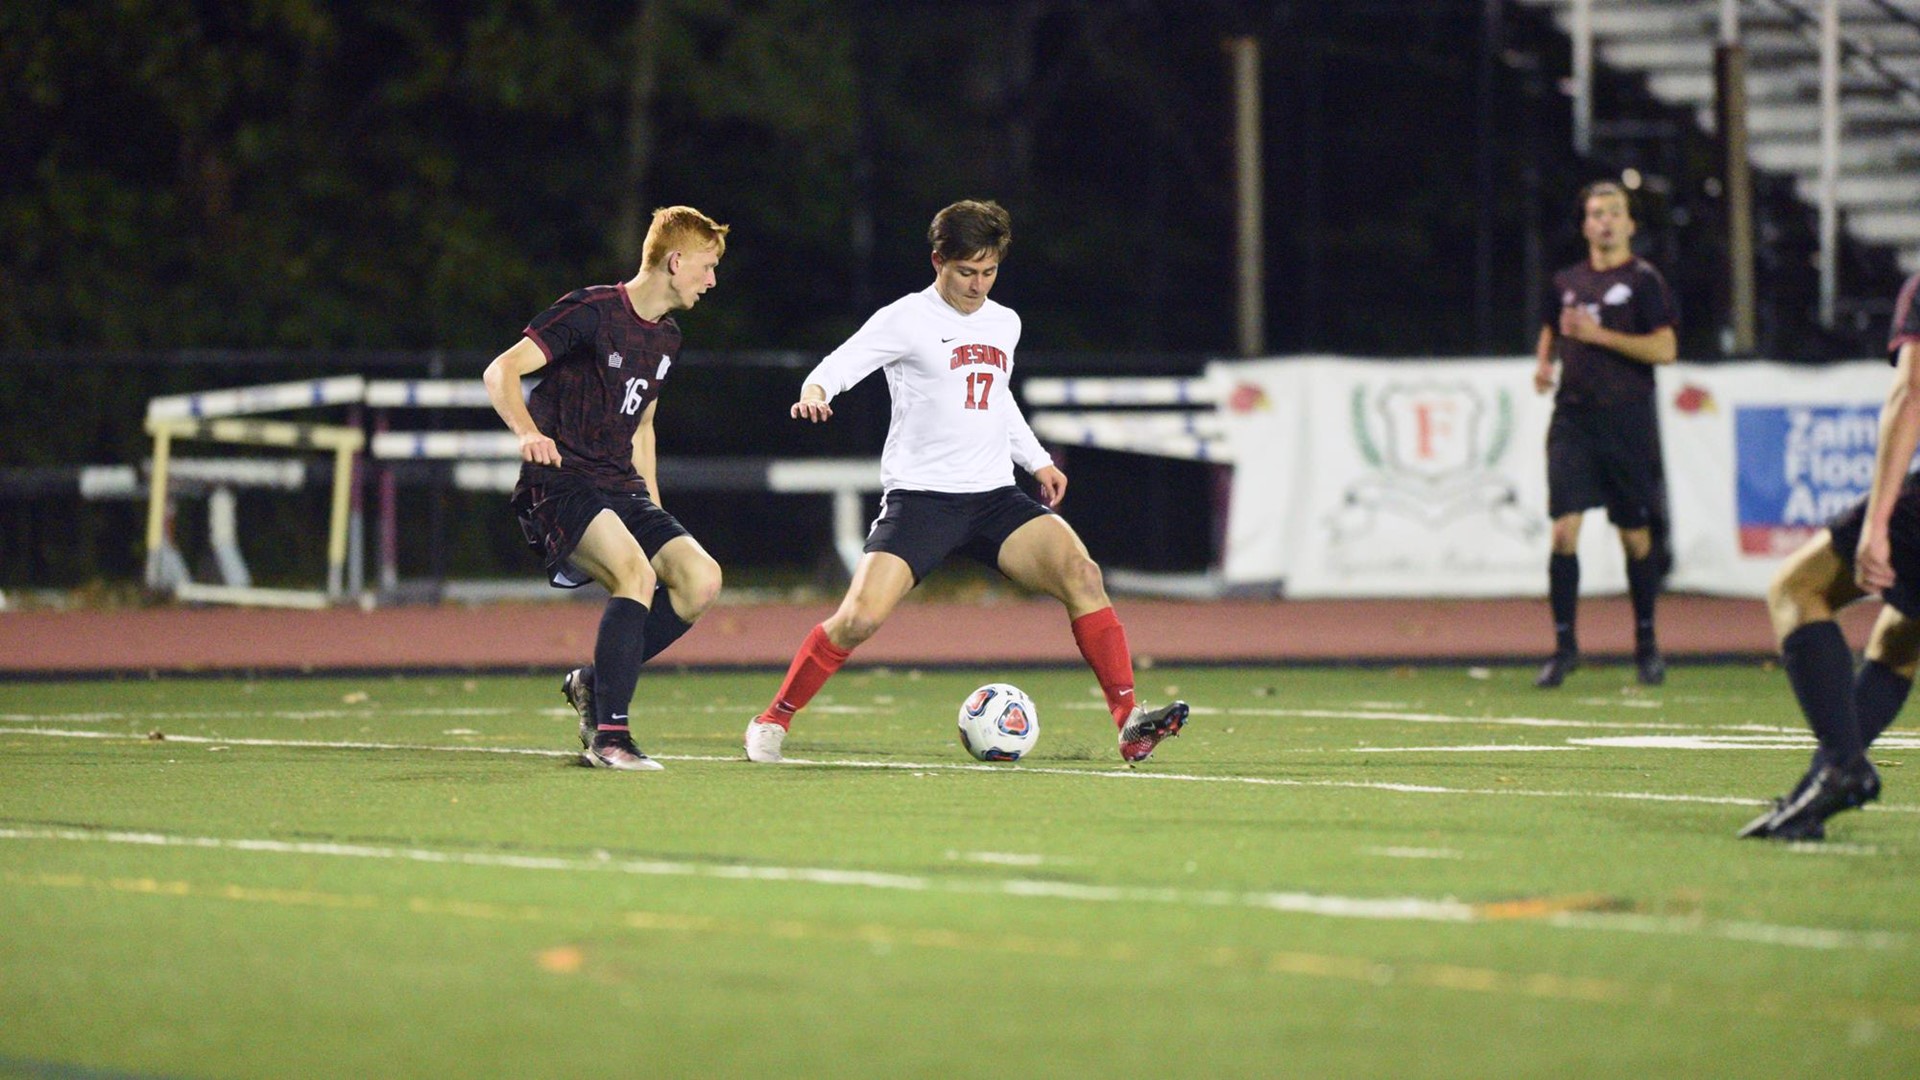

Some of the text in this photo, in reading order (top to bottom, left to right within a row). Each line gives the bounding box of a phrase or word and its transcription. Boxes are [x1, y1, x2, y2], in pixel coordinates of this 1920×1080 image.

[950, 343, 1008, 374] JESUIT
[619, 376, 649, 415] 16
[964, 371, 994, 410] 17
[1412, 398, 1457, 459] F
[1782, 484, 1860, 524] Am
